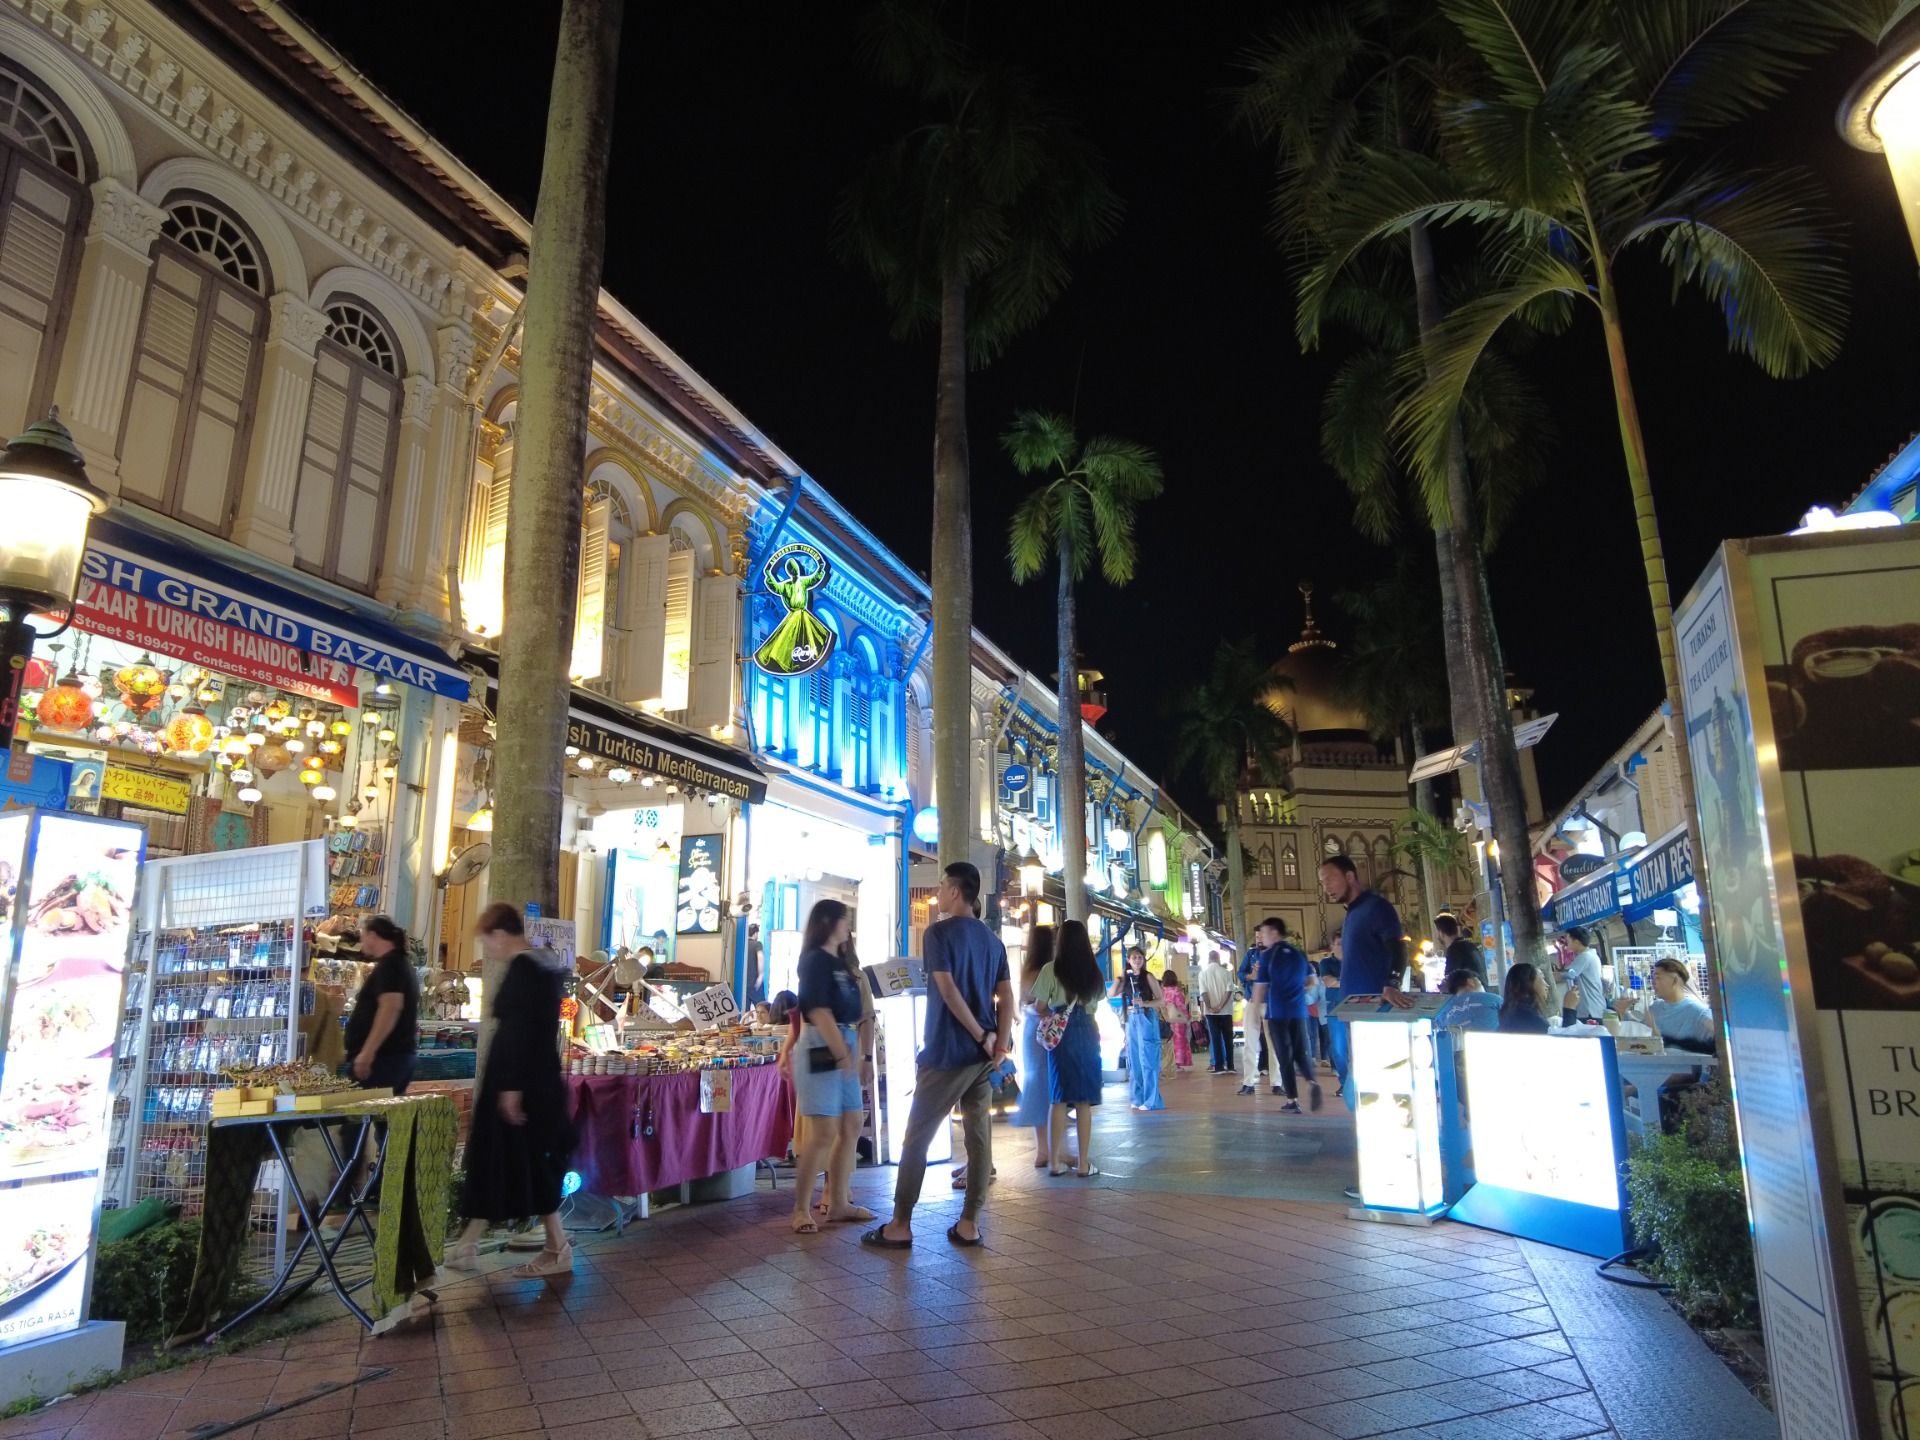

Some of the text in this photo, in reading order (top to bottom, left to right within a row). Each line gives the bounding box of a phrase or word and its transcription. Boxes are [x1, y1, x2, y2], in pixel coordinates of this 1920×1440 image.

[79, 580, 139, 624] ZAAR
[144, 601, 228, 652] TURKISH
[82, 551, 437, 691] SH GRAND BAZAAR
[1690, 613, 1717, 657] TURKISH
[75, 613, 122, 637] Street
[126, 630, 186, 656] S199477
[192, 651, 248, 675] Contact:
[250, 668, 273, 682] +65
[275, 675, 332, 698] 96367644
[1690, 639, 1728, 694] TEA CULTURE
[596, 729, 653, 768] Turkish
[657, 752, 749, 798] Mediterranean
[1633, 835, 1694, 902] SULTAN RES
[1554, 881, 1614, 926] SULTAN RESTAURANT
[697, 997, 734, 1021] $10
[0, 1308, 75, 1335] SS TIGA RASA
